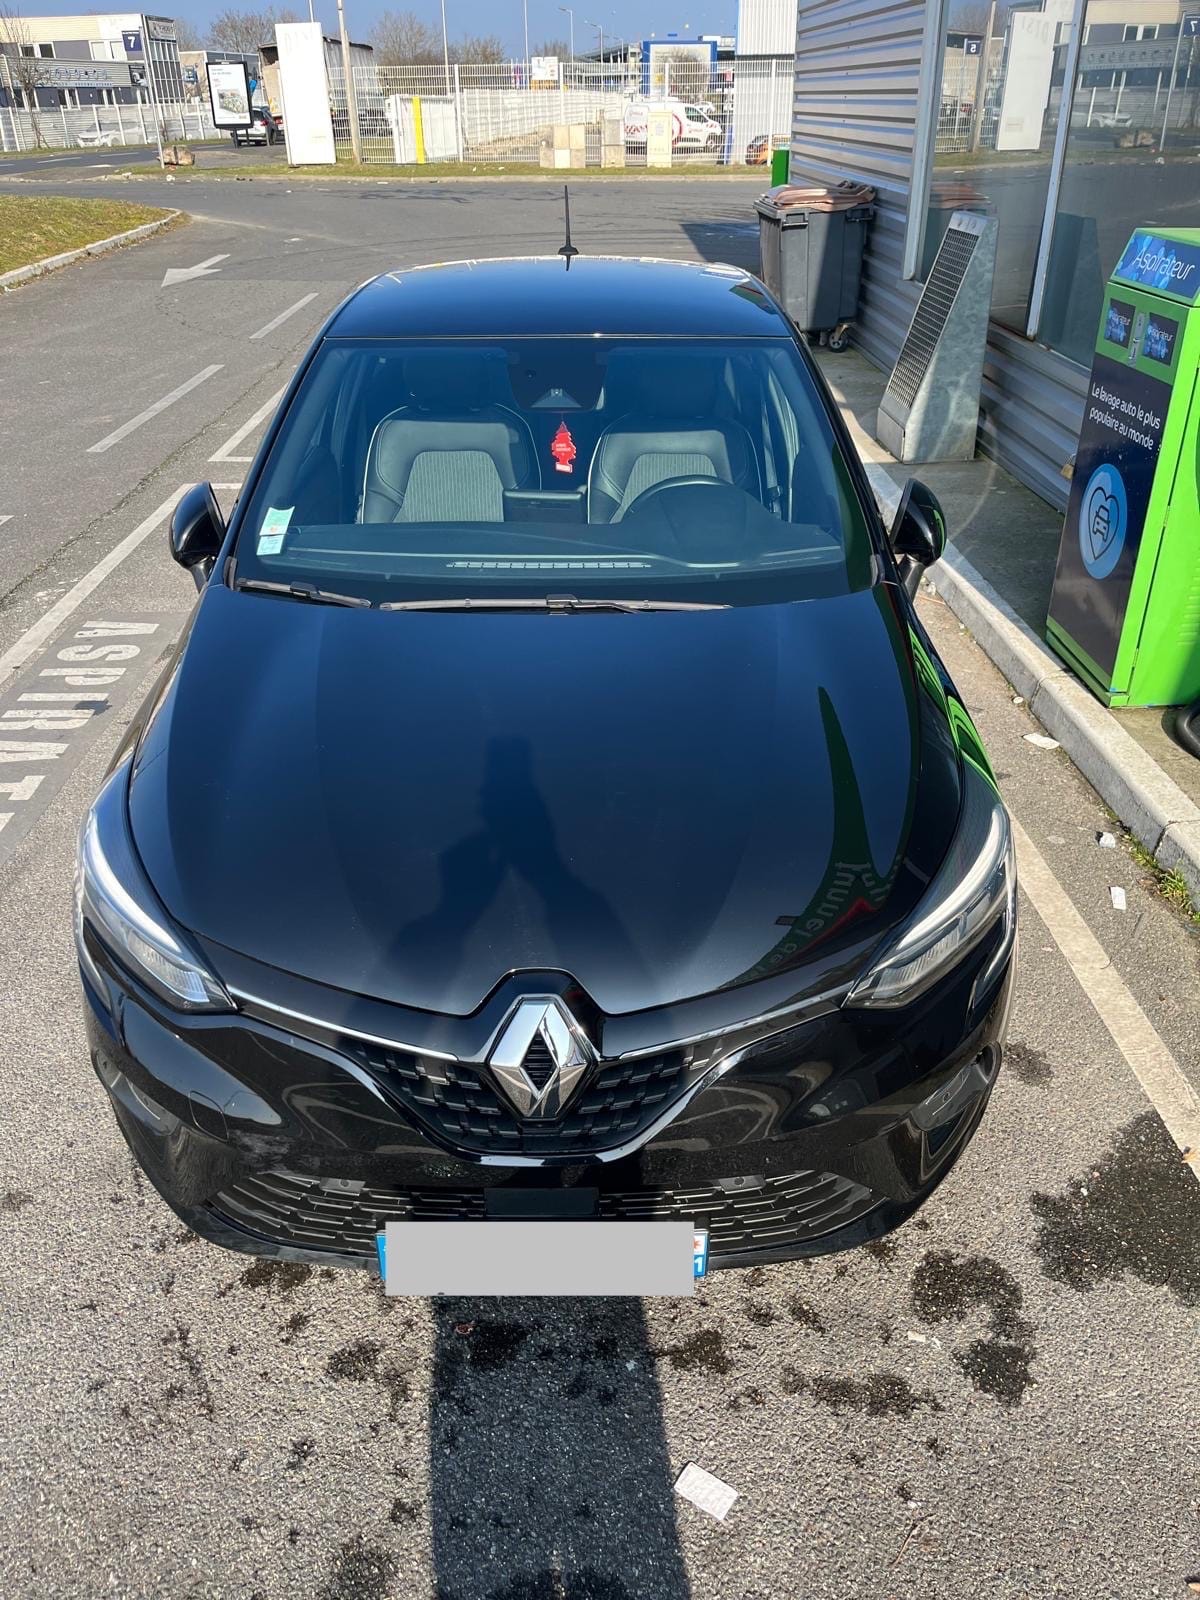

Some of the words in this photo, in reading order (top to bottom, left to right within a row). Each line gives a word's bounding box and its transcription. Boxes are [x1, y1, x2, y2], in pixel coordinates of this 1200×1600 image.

[127, 36, 136, 49] 7
[1131, 248, 1196, 280] Aspirateur
[1091, 382, 1100, 398] Le
[1099, 386, 1120, 410] lavage
[1120, 400, 1137, 417] auto
[1137, 404, 1144, 421] le
[1143, 411, 1160, 429] plus
[1089, 407, 1119, 431] populaire
[1119, 423, 1128, 436] au
[1128, 428, 1154, 450] monde
[0, 620, 160, 832] ASPIRAT
